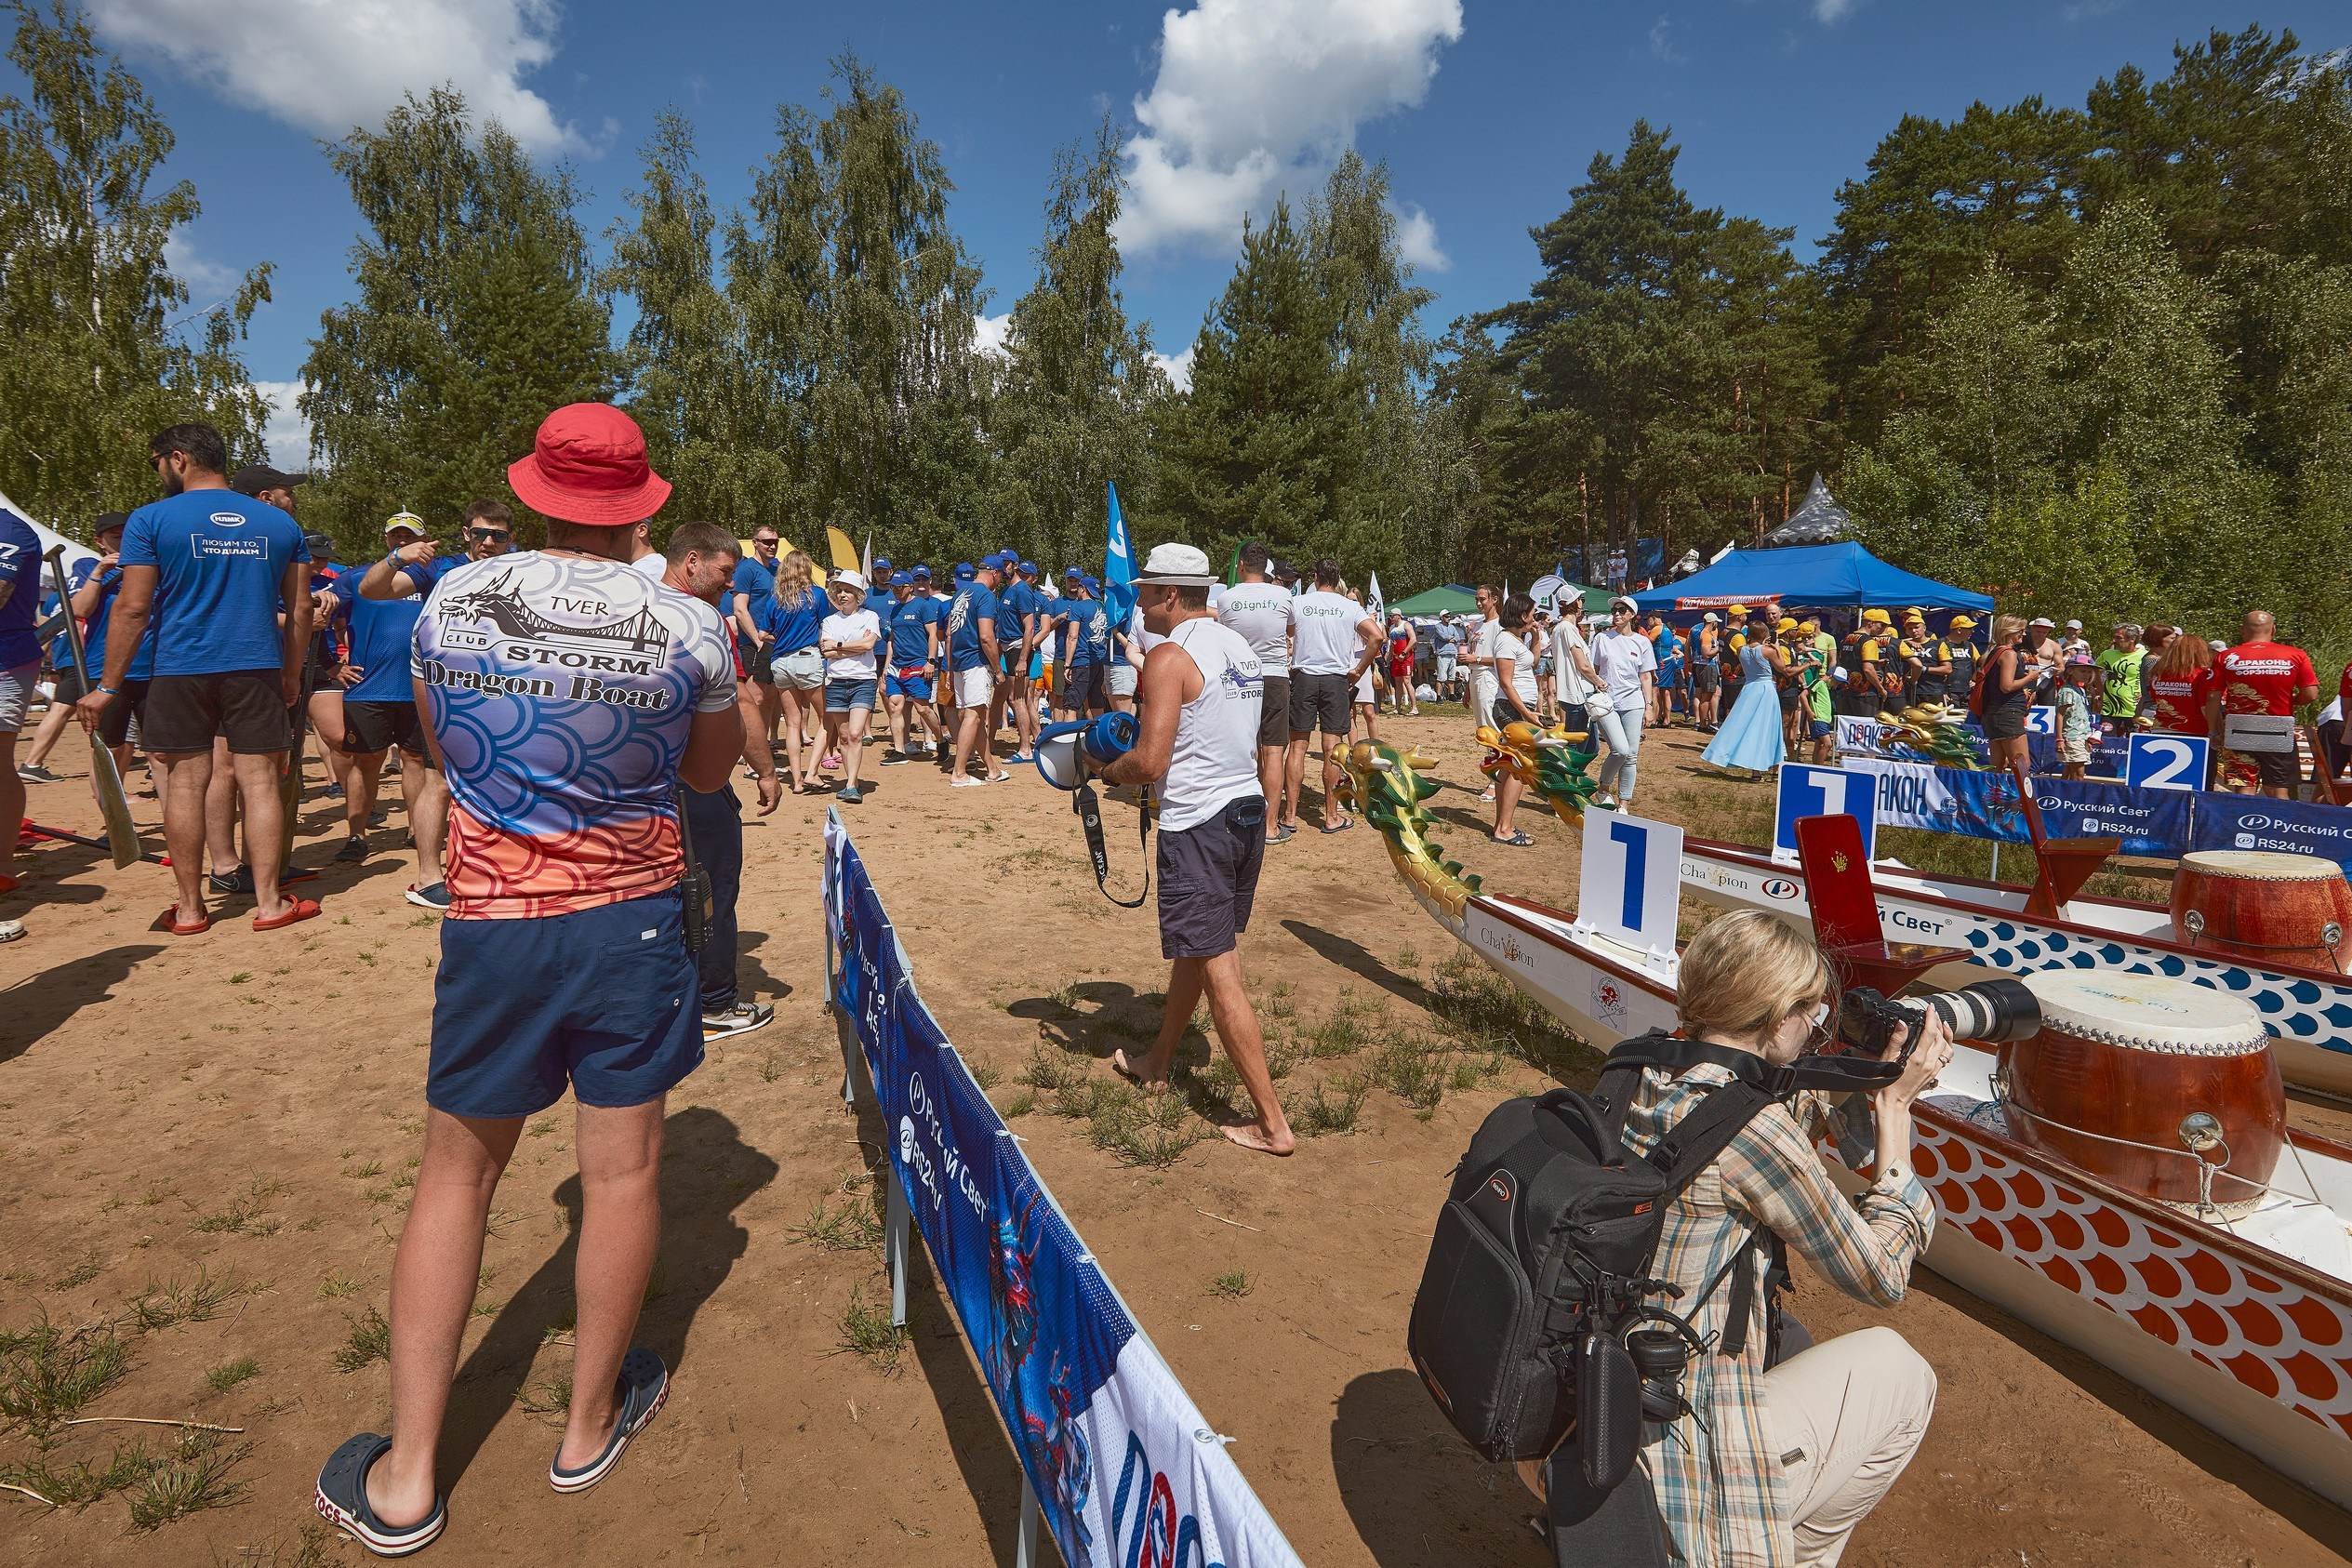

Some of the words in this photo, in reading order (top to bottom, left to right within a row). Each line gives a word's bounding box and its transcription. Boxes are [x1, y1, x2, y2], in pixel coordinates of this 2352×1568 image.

[551, 595, 609, 616] TVER
[446, 633, 487, 645] CLUB
[507, 645, 652, 676] STORM
[1240, 660, 1259, 671] TVER
[2235, 658, 2291, 667] ДРАКОНЫ
[423, 658, 556, 699] Dragon
[565, 674, 670, 711] Boat
[2029, 708, 2050, 734] 3
[2140, 738, 2193, 791] 2
[1808, 771, 1847, 816] 1
[2064, 800, 2116, 813] Русский
[2101, 822, 2149, 835] RS24.ru
[2273, 819, 2338, 837] Русский
[2258, 838, 2314, 854] RS24.ru
[1611, 821, 1648, 933] 1
